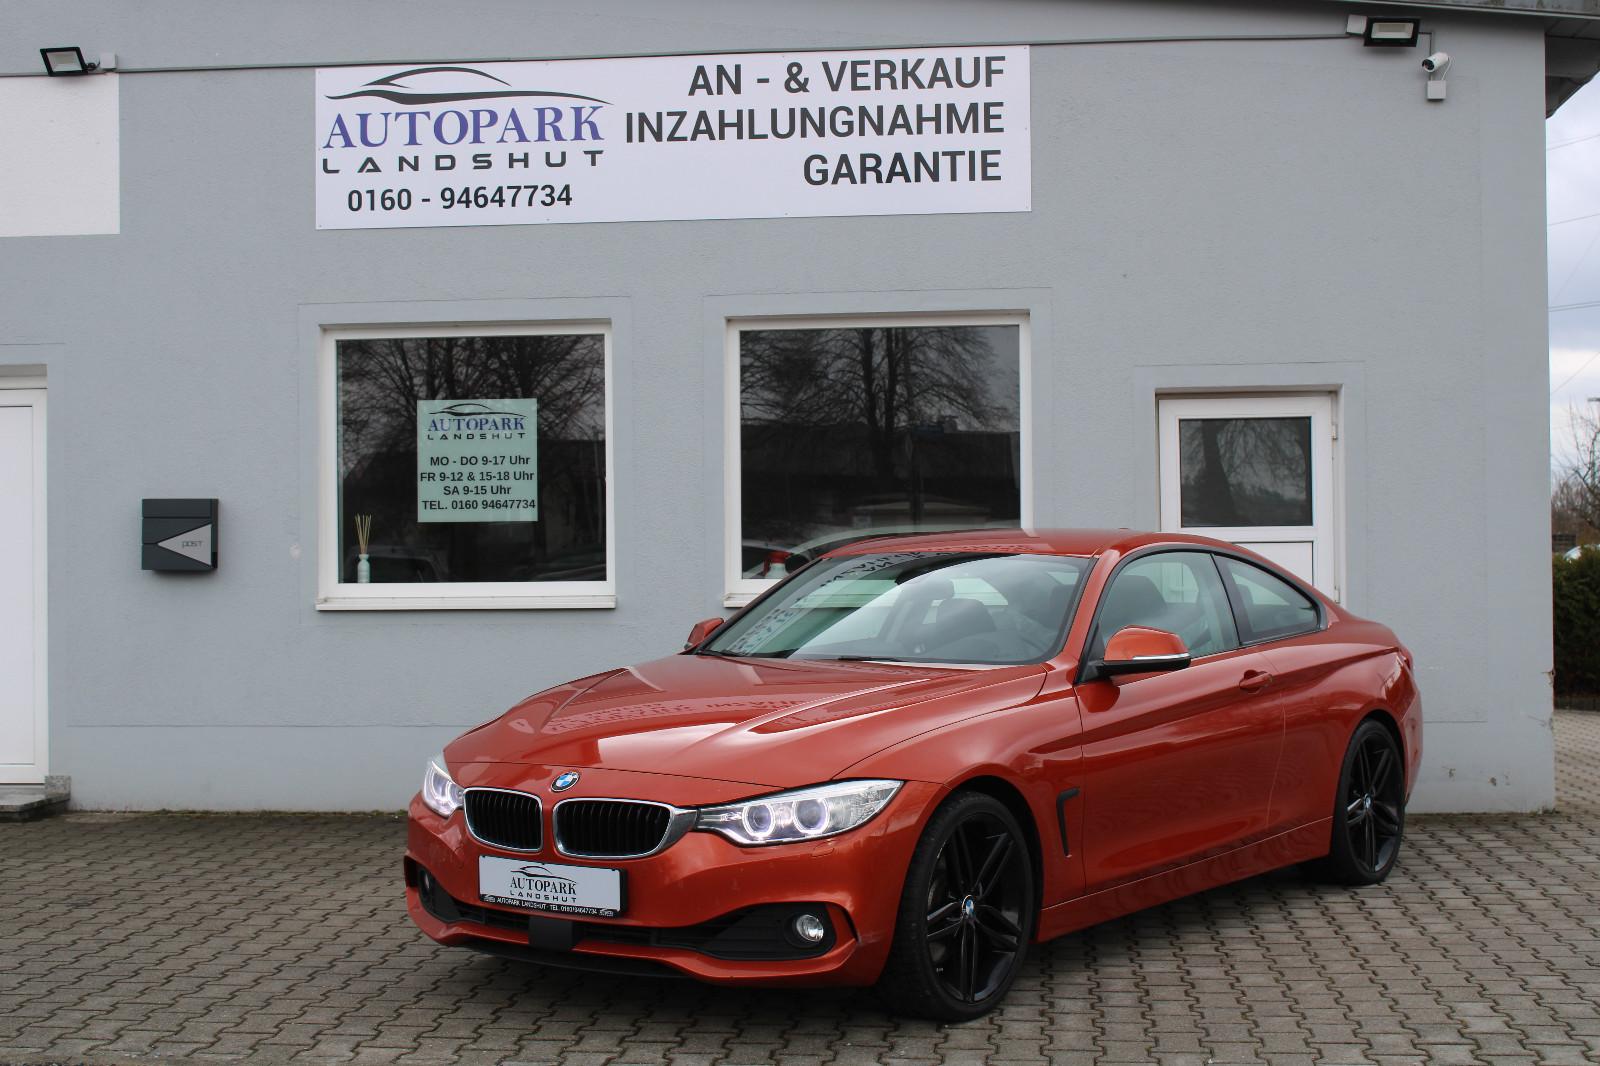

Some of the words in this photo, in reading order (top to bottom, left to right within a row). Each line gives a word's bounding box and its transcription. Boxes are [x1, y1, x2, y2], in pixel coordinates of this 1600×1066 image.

[688, 63, 742, 96] AN
[783, 61, 810, 94] &
[821, 55, 1006, 92] VERKAUF
[322, 105, 605, 149] AUTOPARK
[625, 101, 1005, 144] INZAHLUNGNAHME
[322, 150, 605, 174] LANDSHUT
[803, 149, 1002, 186] GARANTIE
[347, 188, 412, 212] 0160
[440, 184, 573, 209] 94647734
[428, 417, 526, 431] AUTOPARK
[427, 432, 526, 440] LANDSHUT
[430, 456, 450, 466] MO
[460, 456, 479, 466] DO
[481, 455, 506, 466] 9-17
[509, 455, 531, 465] Uhr
[420, 472, 436, 481] FR
[439, 472, 463, 482] 9-12
[467, 471, 476, 481] &
[479, 471, 510, 481] 15-18
[513, 471, 535, 480] Uhr
[443, 485, 460, 495] SA
[463, 485, 487, 495] 9-15
[490, 485, 512, 494] Uhr
[422, 500, 448, 510] TEL.
[451, 500, 478, 509] 0160
[481, 499, 536, 509] 94647734
[510, 876, 577, 895] AUTOPARK
[510, 890, 577, 903] LANDSHUT
